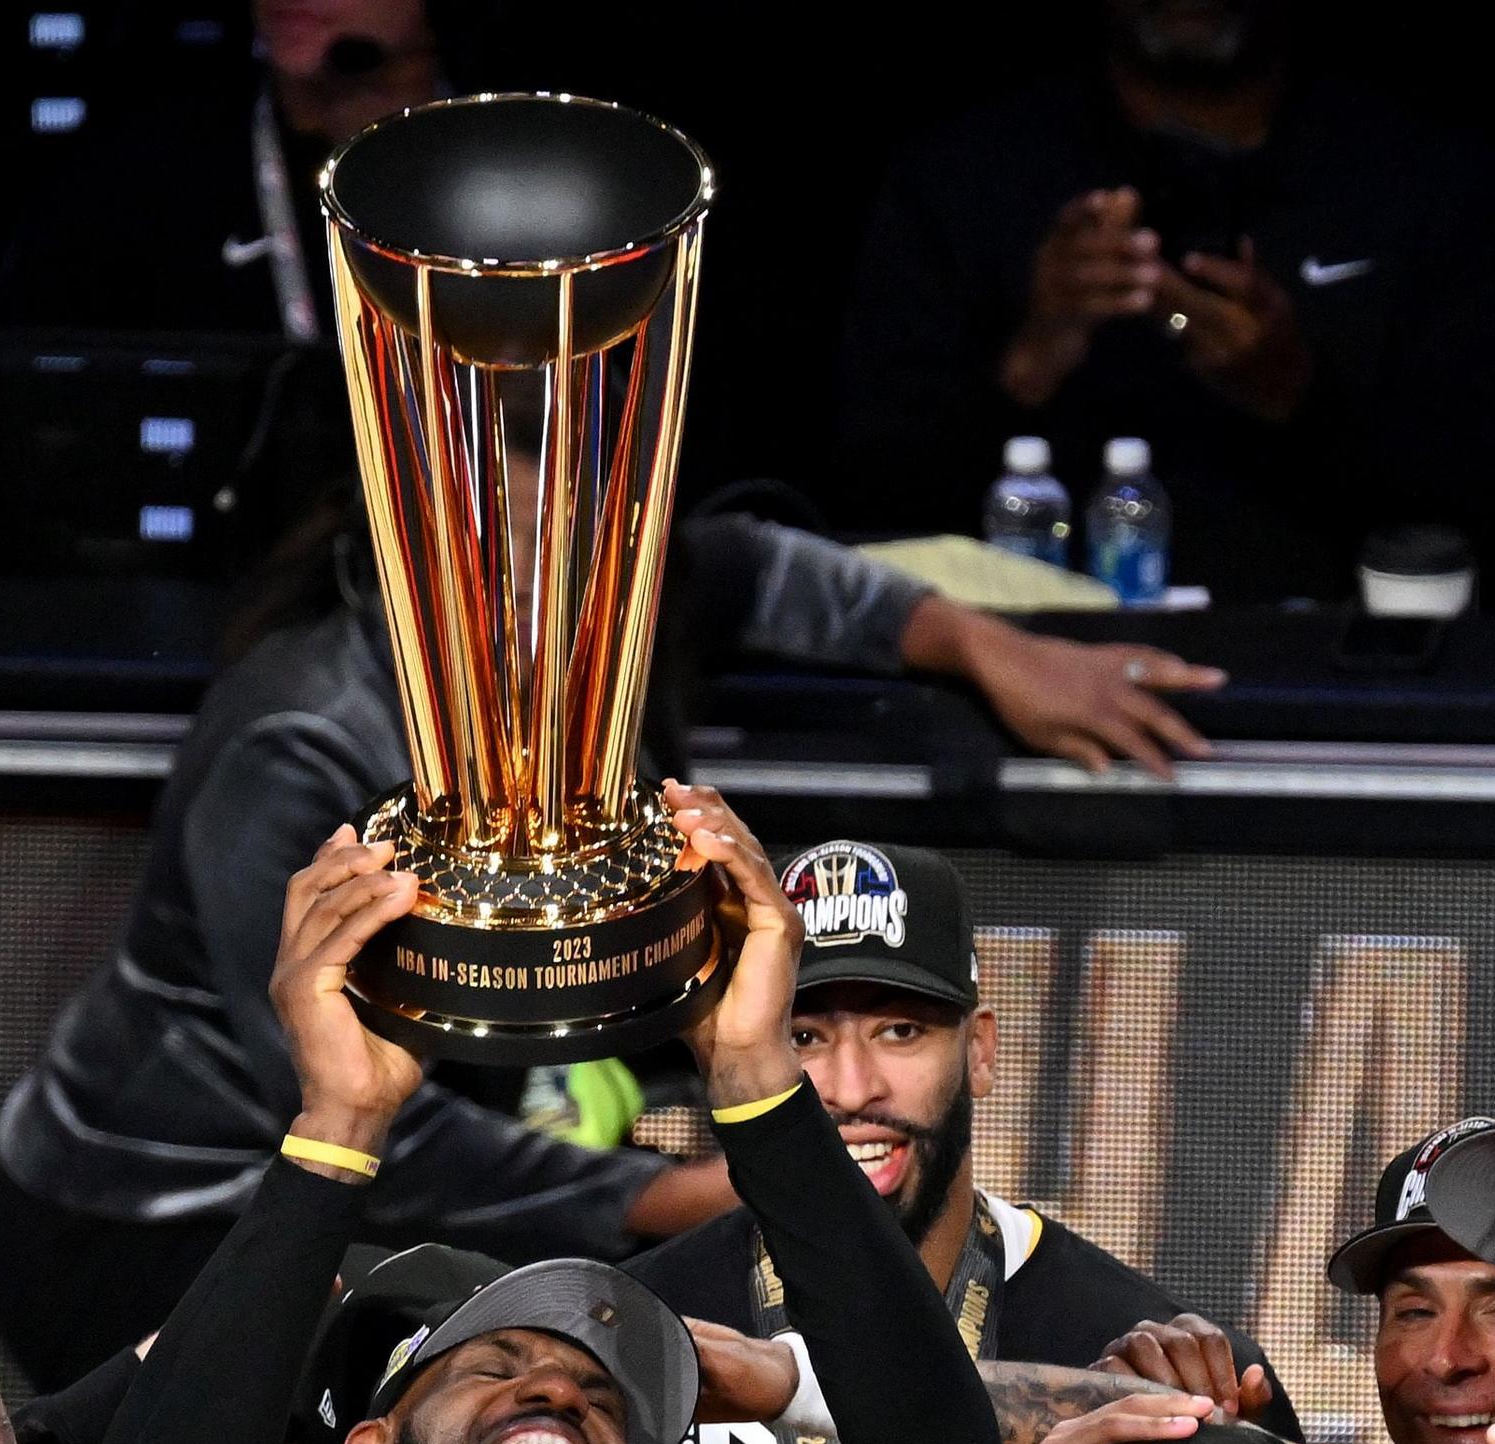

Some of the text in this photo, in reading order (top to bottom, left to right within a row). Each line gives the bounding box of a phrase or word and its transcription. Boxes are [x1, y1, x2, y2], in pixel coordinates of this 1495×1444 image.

[796, 889, 908, 946] AMPIONS
[396, 909, 706, 990] NBA IN-SEASON TOURNAMENT CHAMPIONS
[552, 936, 592, 963] 2023
